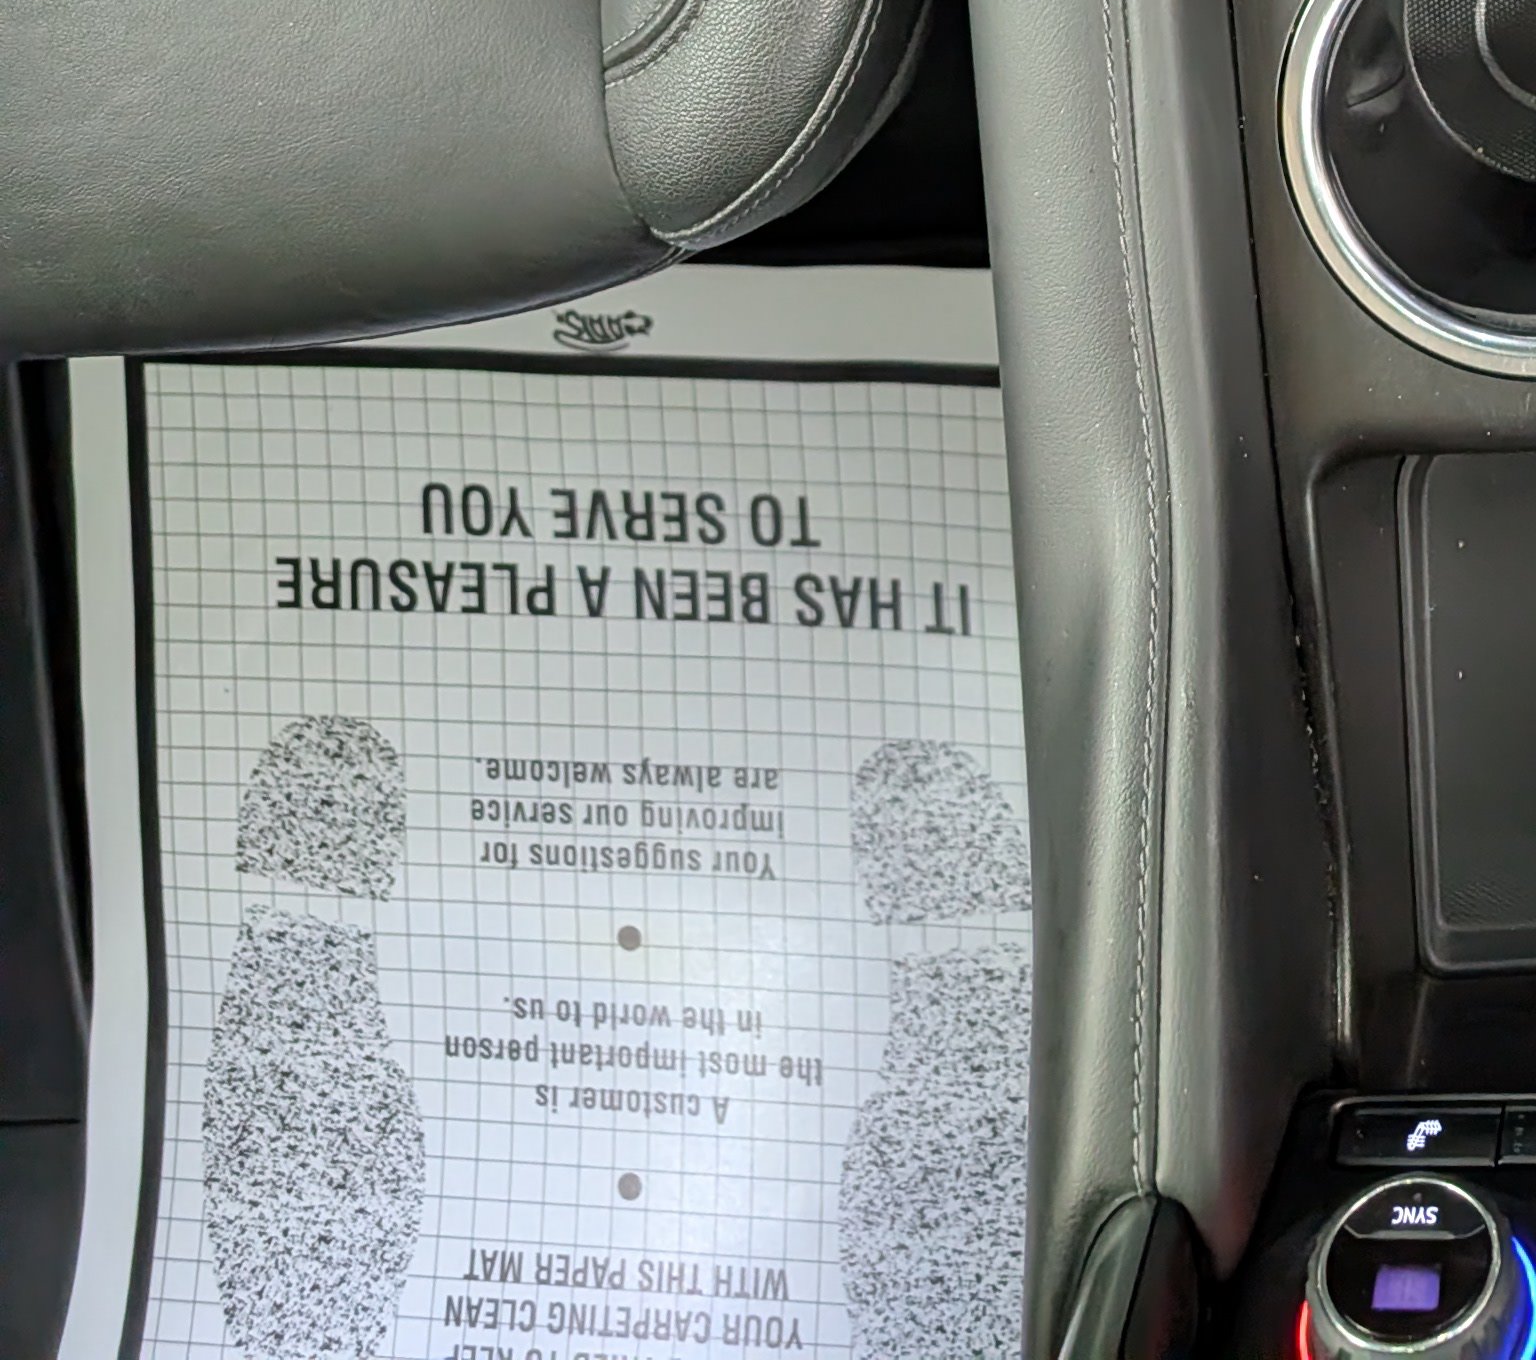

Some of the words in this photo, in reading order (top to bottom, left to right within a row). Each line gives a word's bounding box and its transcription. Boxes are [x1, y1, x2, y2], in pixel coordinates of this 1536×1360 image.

[422, 482, 532, 538] YOU
[550, 488, 726, 545] SERVE
[750, 494, 821, 547] TO
[276, 557, 556, 616] PLEASURE
[576, 565, 611, 617] A
[634, 567, 770, 624] BEEN
[794, 574, 902, 631] HAS
[924, 582, 969, 636] IT
[475, 757, 611, 788] welcome.
[623, 757, 722, 793] always
[734, 766, 779, 791] are
[471, 798, 573, 828] service
[583, 803, 628, 827] our
[641, 800, 784, 839] improving
[480, 842, 518, 870] for
[529, 841, 701, 873] suggestions
[712, 850, 775, 880] Your
[504, 996, 544, 1020] us.
[557, 1000, 581, 1027] to
[594, 1002, 671, 1032] world
[682, 1007, 725, 1036] the
[737, 1009, 762, 1039] in
[444, 1034, 539, 1063] person
[550, 1041, 686, 1077] important
[698, 1051, 767, 1080] most
[780, 1057, 823, 1086] the
[535, 1084, 558, 1113] is
[570, 1086, 700, 1119] customer
[712, 1096, 730, 1125] A
[1392, 1206, 1439, 1226] SYNC
[463, 1248, 523, 1282] MAT
[535, 1252, 626, 1290] PAPER
[638, 1259, 703, 1296] THIS
[714, 1265, 788, 1301] WITH
[443, 1295, 536, 1333] CLEAN
[548, 1300, 711, 1344] CARPETING
[722, 1314, 803, 1350] YOUR
